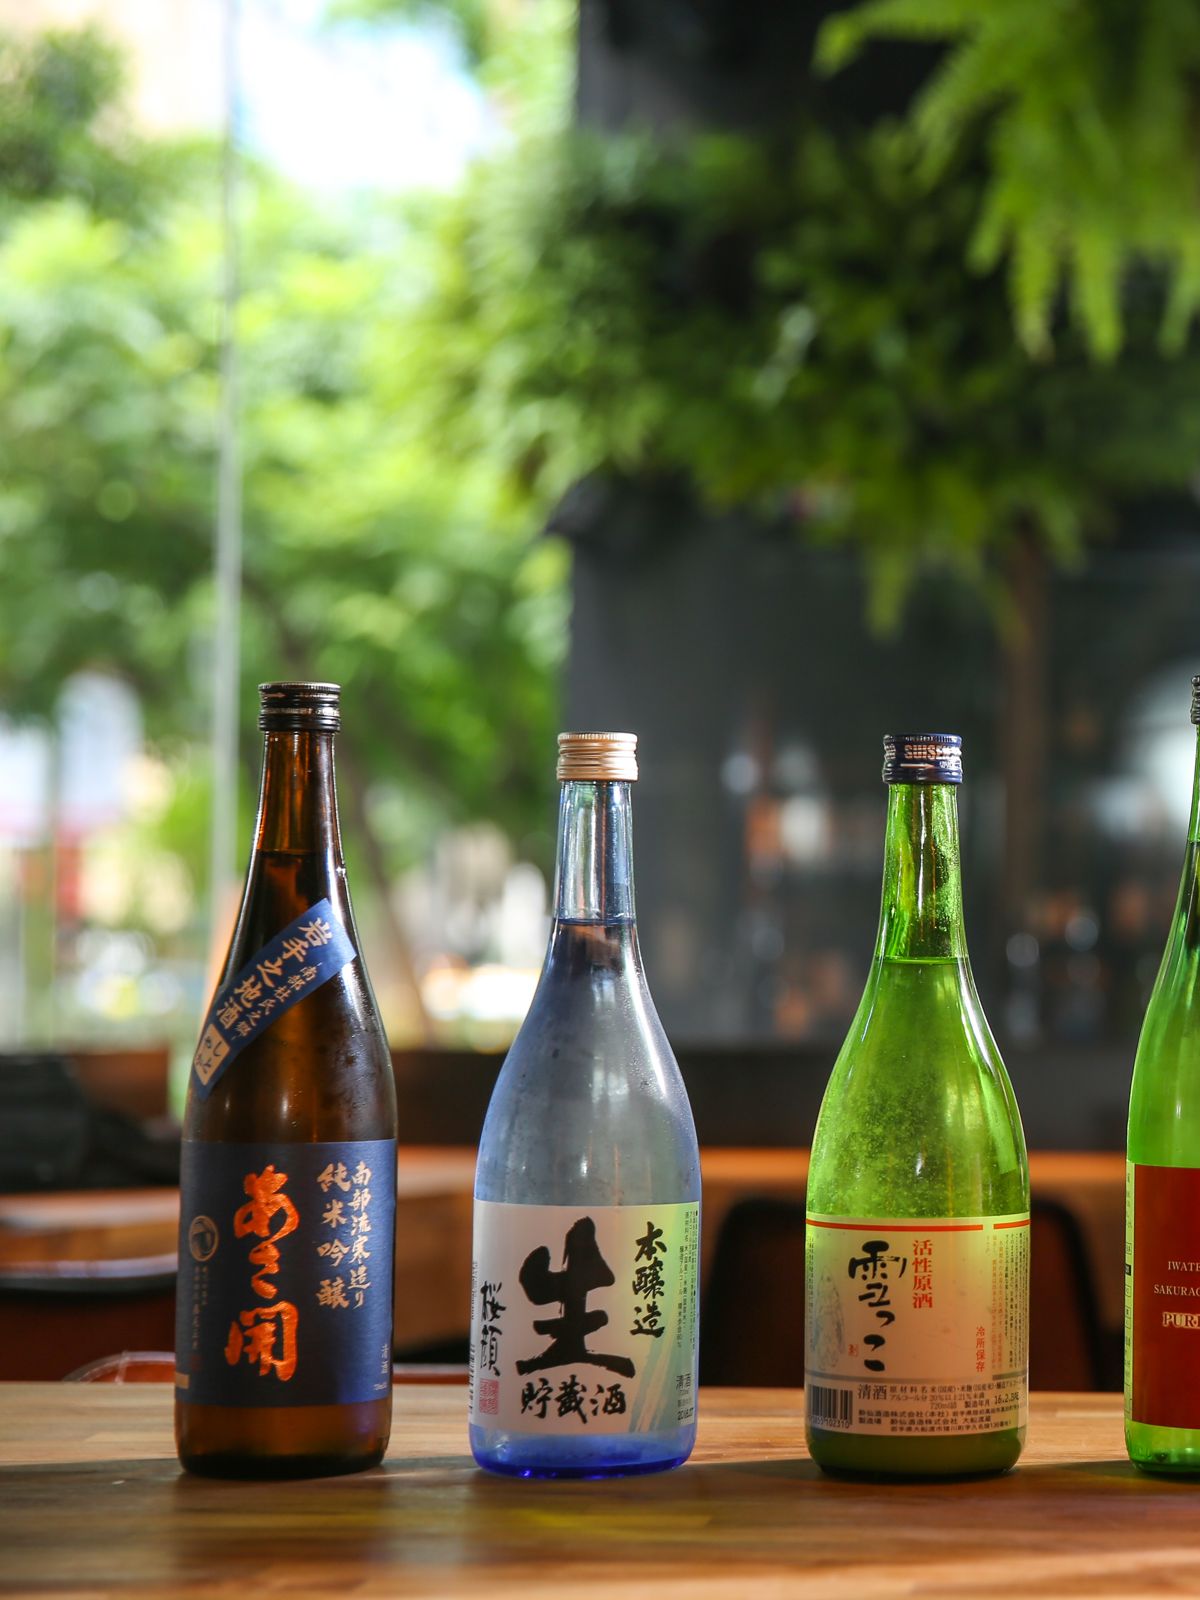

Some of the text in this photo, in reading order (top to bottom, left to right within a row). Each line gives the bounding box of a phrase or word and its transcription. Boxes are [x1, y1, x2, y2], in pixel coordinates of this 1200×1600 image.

[216, 917, 333, 1030] 岩手之地酒
[315, 1162, 351, 1309] 純米吟醸
[347, 1161, 372, 1309] 南部流寒造り
[630, 1221, 668, 1339] 本醸造
[912, 1239, 934, 1309] 活性原酒
[479, 1281, 507, 1376] 桜顔
[515, 1216, 636, 1379] 生
[976, 1326, 986, 1373] 冷所保存
[520, 1375, 627, 1424] 貯蔵酒
[858, 1384, 887, 1400] 清酒
